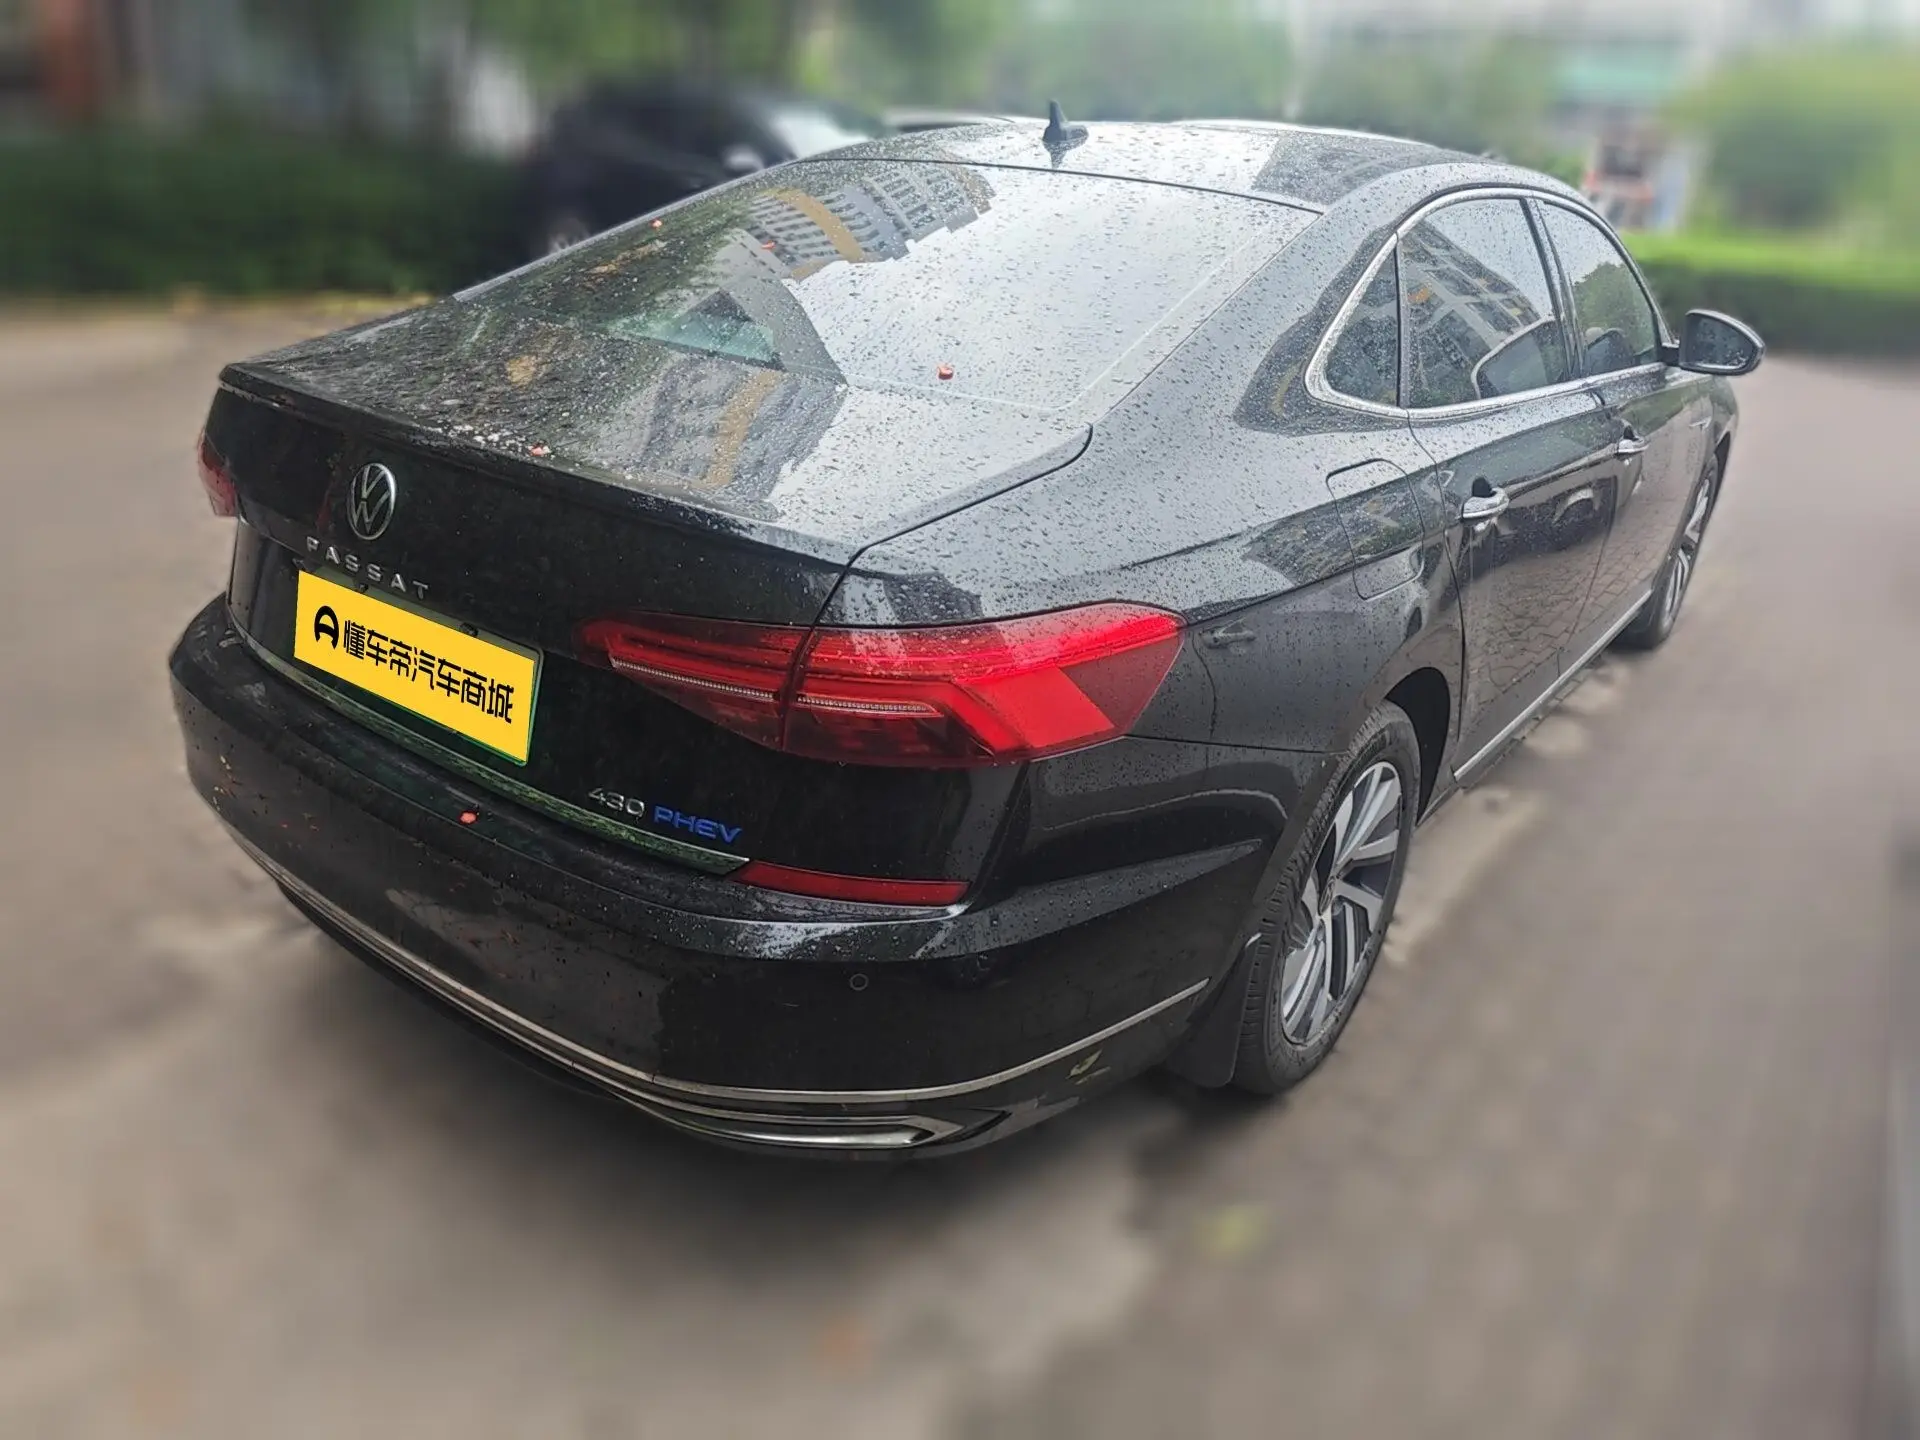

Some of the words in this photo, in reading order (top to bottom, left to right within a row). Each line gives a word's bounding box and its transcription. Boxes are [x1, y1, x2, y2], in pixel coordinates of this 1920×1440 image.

[306, 536, 429, 600] PASSAT
[588, 787, 646, 818] 430
[654, 804, 743, 844] PHEV
